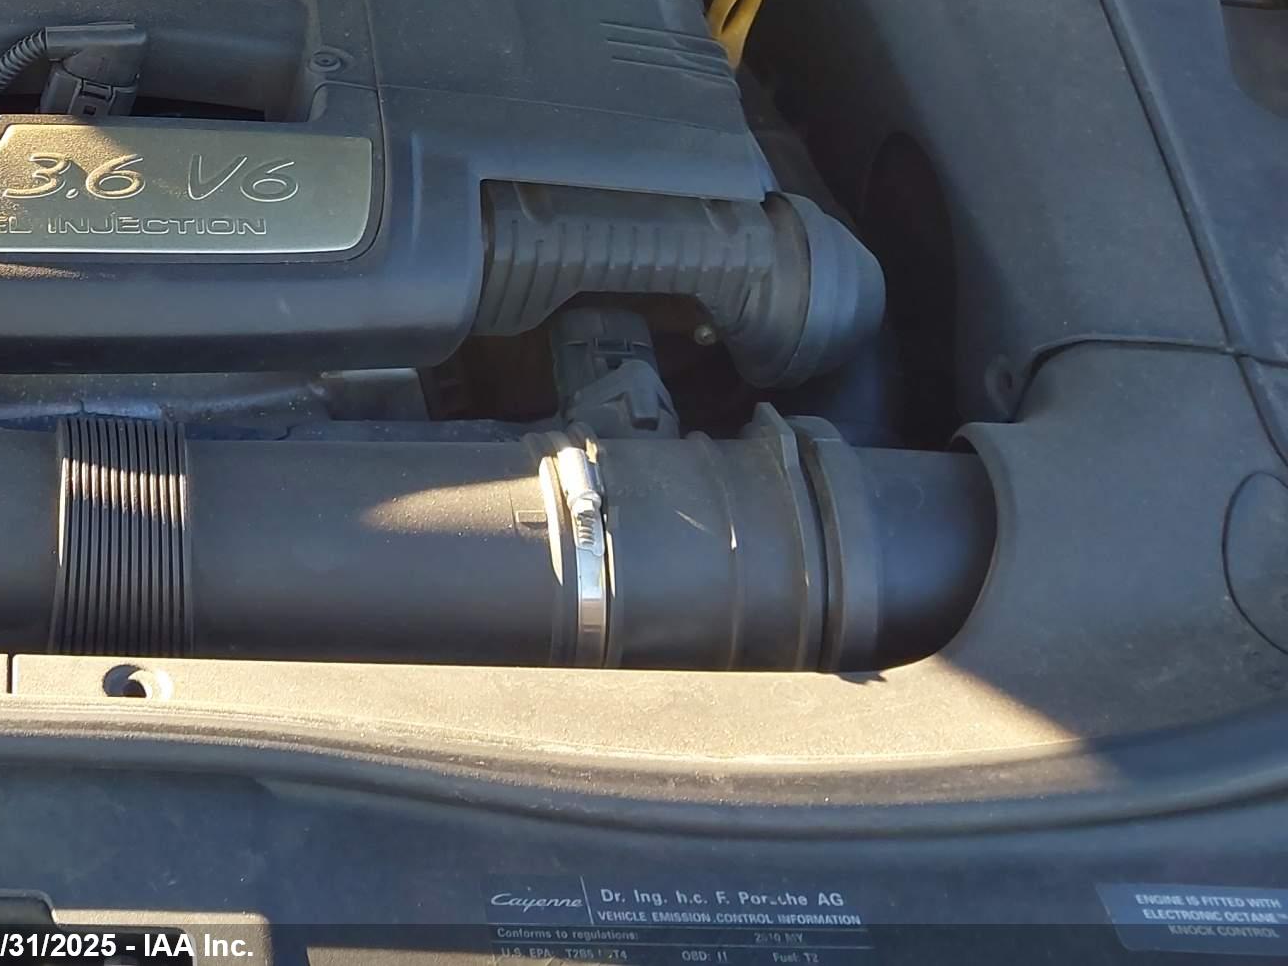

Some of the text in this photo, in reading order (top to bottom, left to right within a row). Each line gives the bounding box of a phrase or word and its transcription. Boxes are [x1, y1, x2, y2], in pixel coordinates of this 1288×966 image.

[3, 152, 299, 202] 3.6 V6
[48, 216, 266, 236] INJECTION
[491, 892, 583, 913] Cayenne
[600, 888, 625, 903] Dr.
[634, 889, 667, 906] Ing.
[676, 890, 708, 905] h.c.
[715, 891, 730, 905] F.
[817, 892, 844, 907] AG
[1135, 894, 1282, 909] ENGINE IS FITTED WITH
[597, 911, 647, 922] VEHICLE
[652, 912, 711, 923] EMISSION
[777, 914, 861, 925] INFORMATION
[1142, 909, 1223, 921] ELECTRONIC
[497, 928, 552, 939] Conforms
[555, 930, 568, 939] to
[1168, 924, 1280, 938] KNOCK CONTROL
